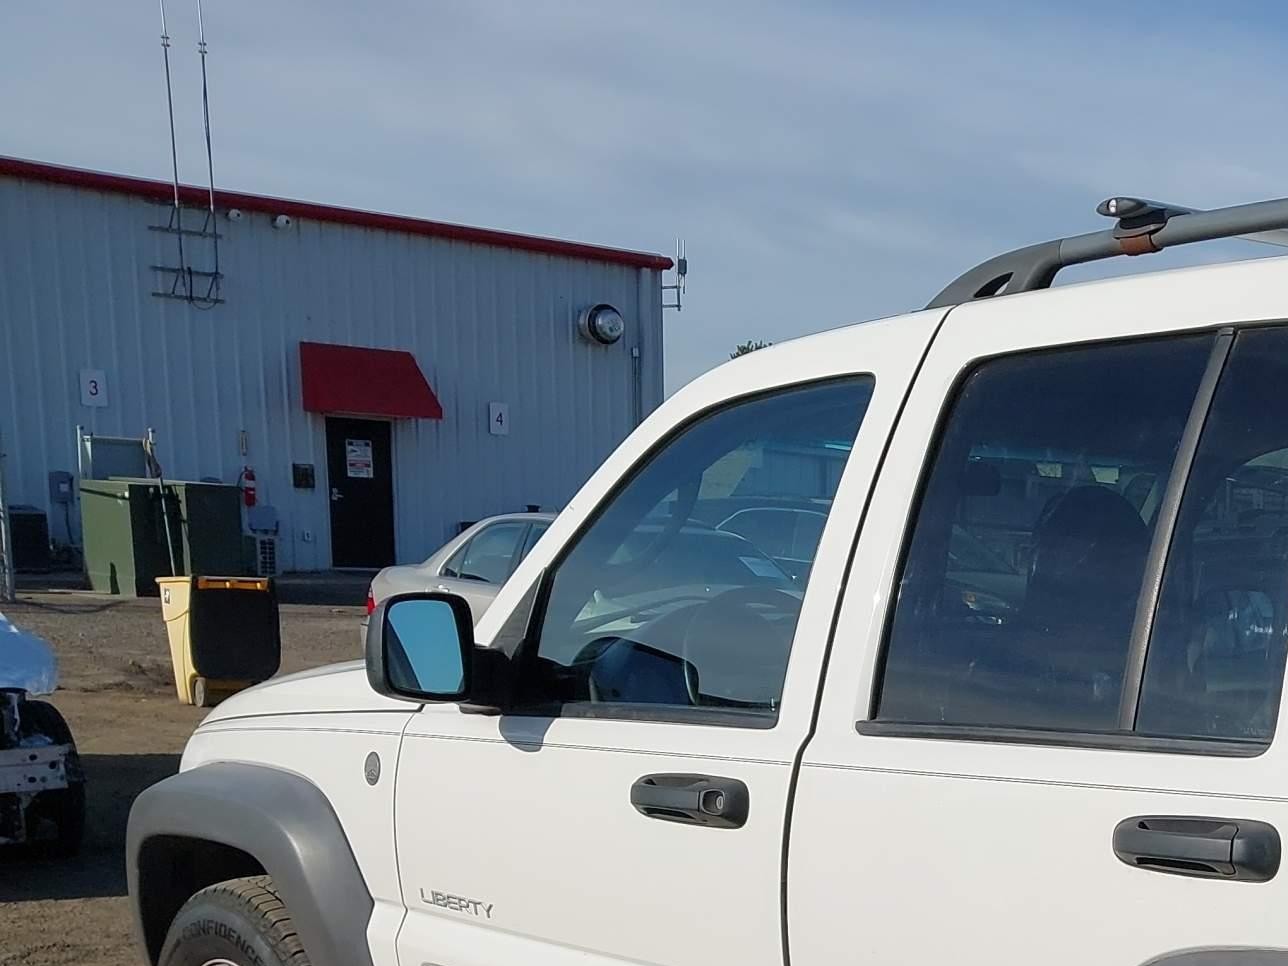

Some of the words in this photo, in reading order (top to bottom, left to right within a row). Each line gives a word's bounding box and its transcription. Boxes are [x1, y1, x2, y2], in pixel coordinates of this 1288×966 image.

[88, 379, 99, 396] 3
[495, 411, 504, 426] 4
[419, 887, 494, 919] LIBERTY
[181, 919, 264, 966] CONFIDENCE
